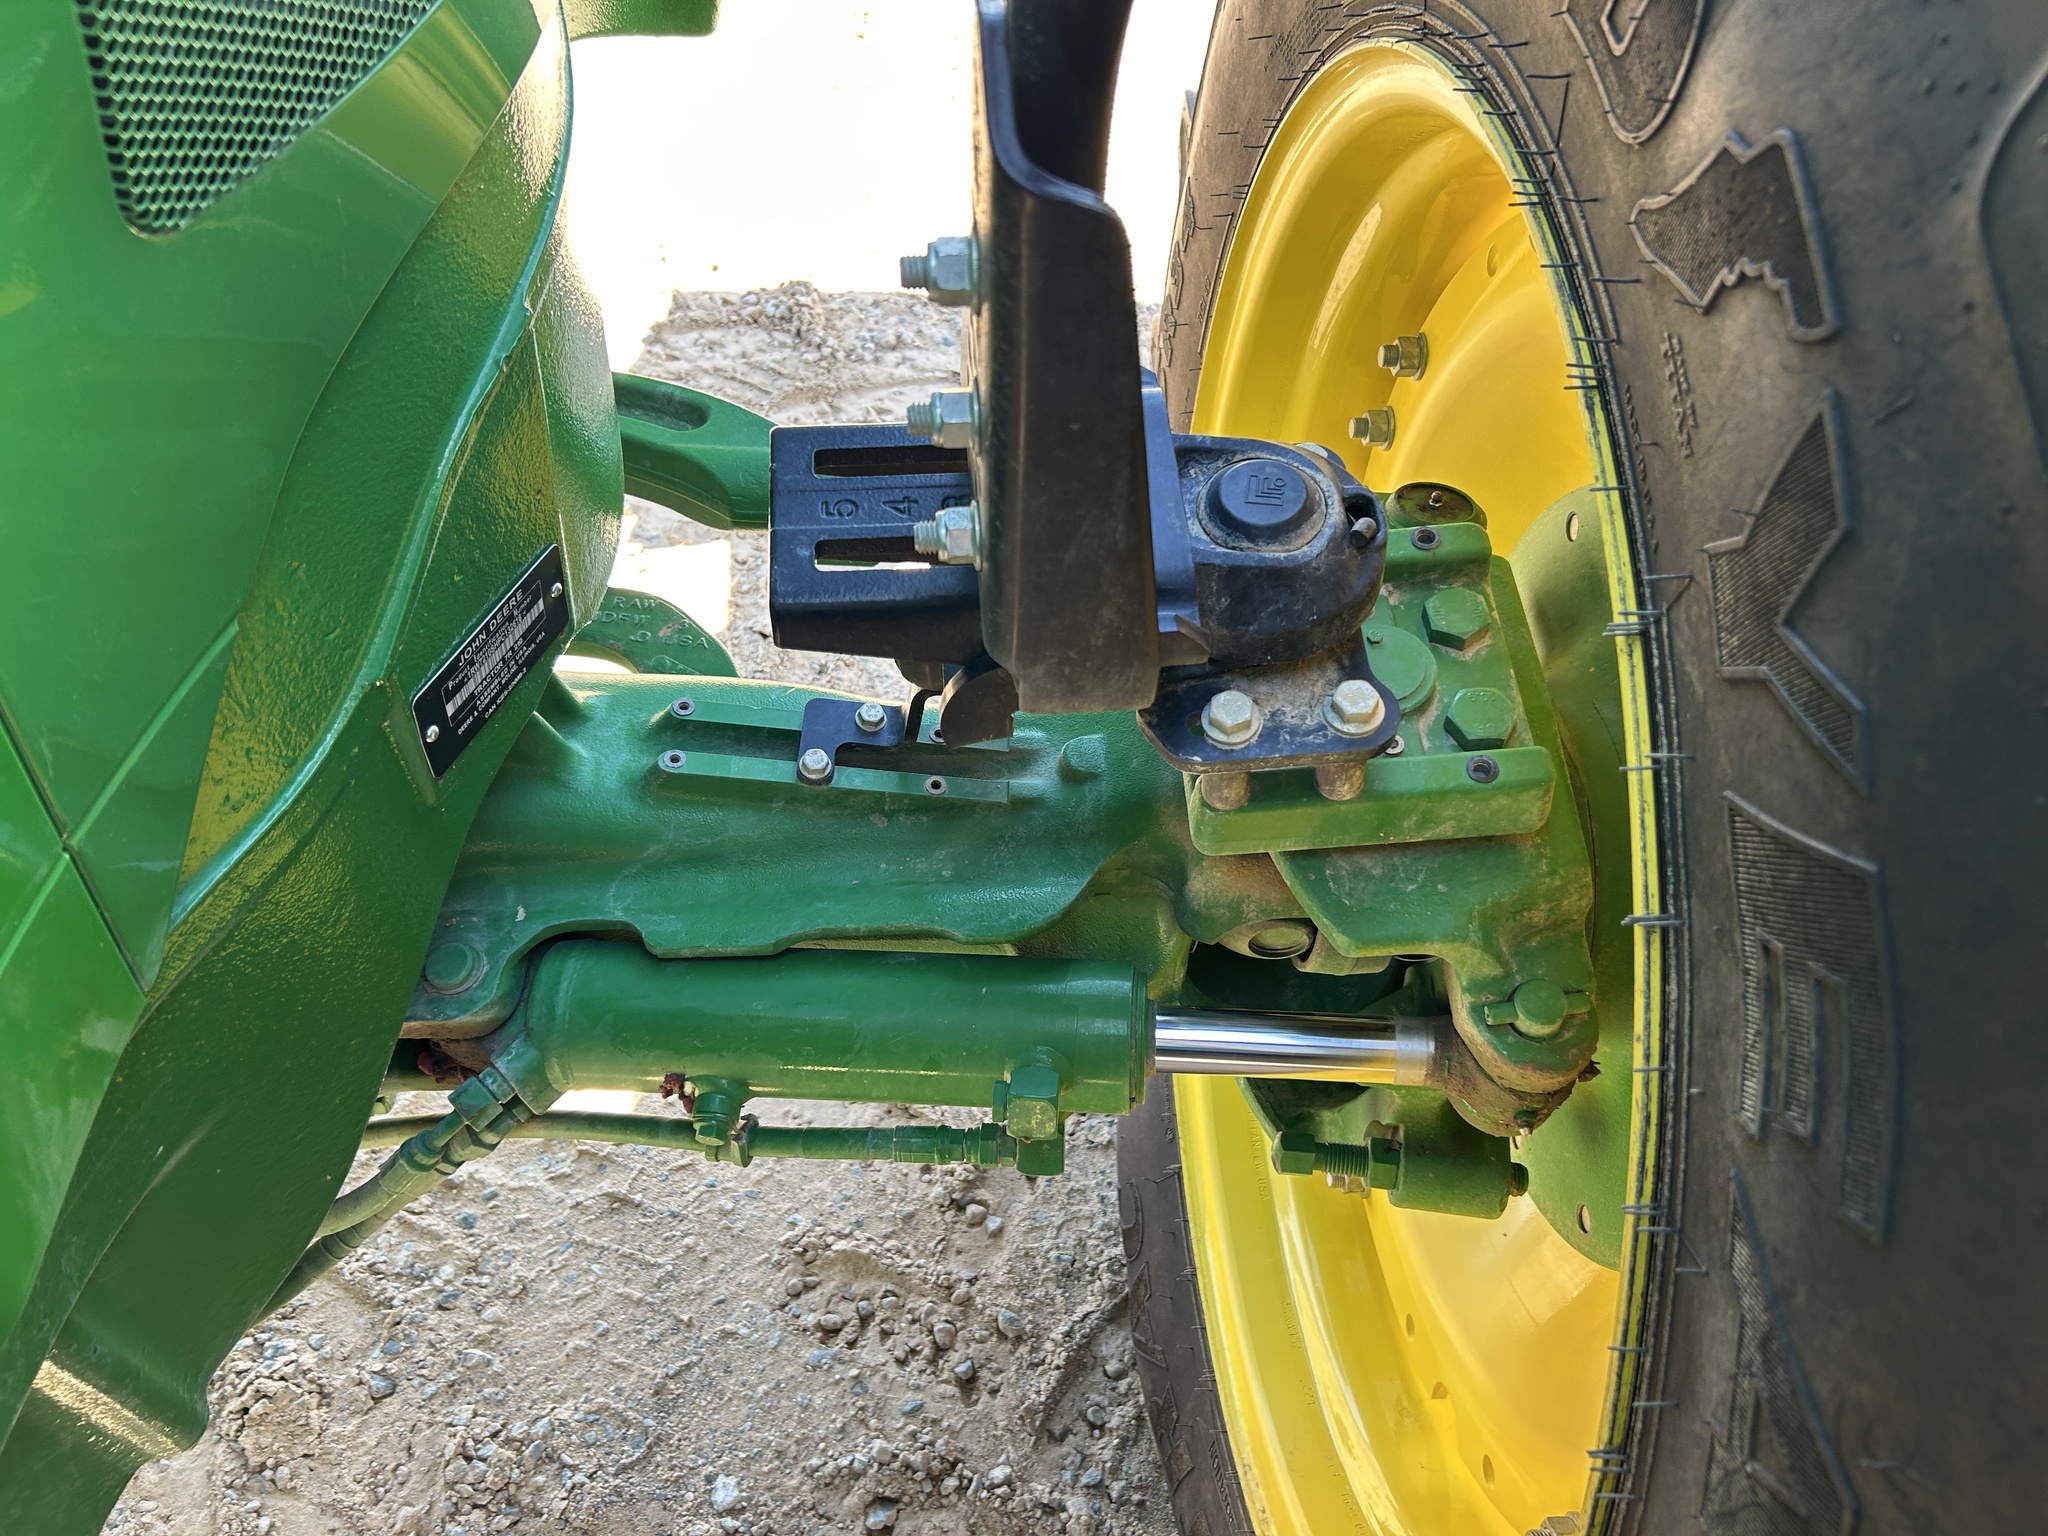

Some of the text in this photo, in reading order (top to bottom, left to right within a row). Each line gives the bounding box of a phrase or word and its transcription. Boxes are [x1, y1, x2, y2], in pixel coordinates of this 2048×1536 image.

[821, 497, 861, 520] 5
[881, 495, 920, 518] 4
[458, 589, 523, 667] JOHN DEERE
[448, 593, 532, 691] Product Identification Number
[515, 645, 527, 660] USA
[662, 634, 709, 650] USA
[474, 661, 503, 697] TRACTOR
[458, 715, 473, 735] DEERE
[1208, 1440, 1234, 1525] ROTATION
